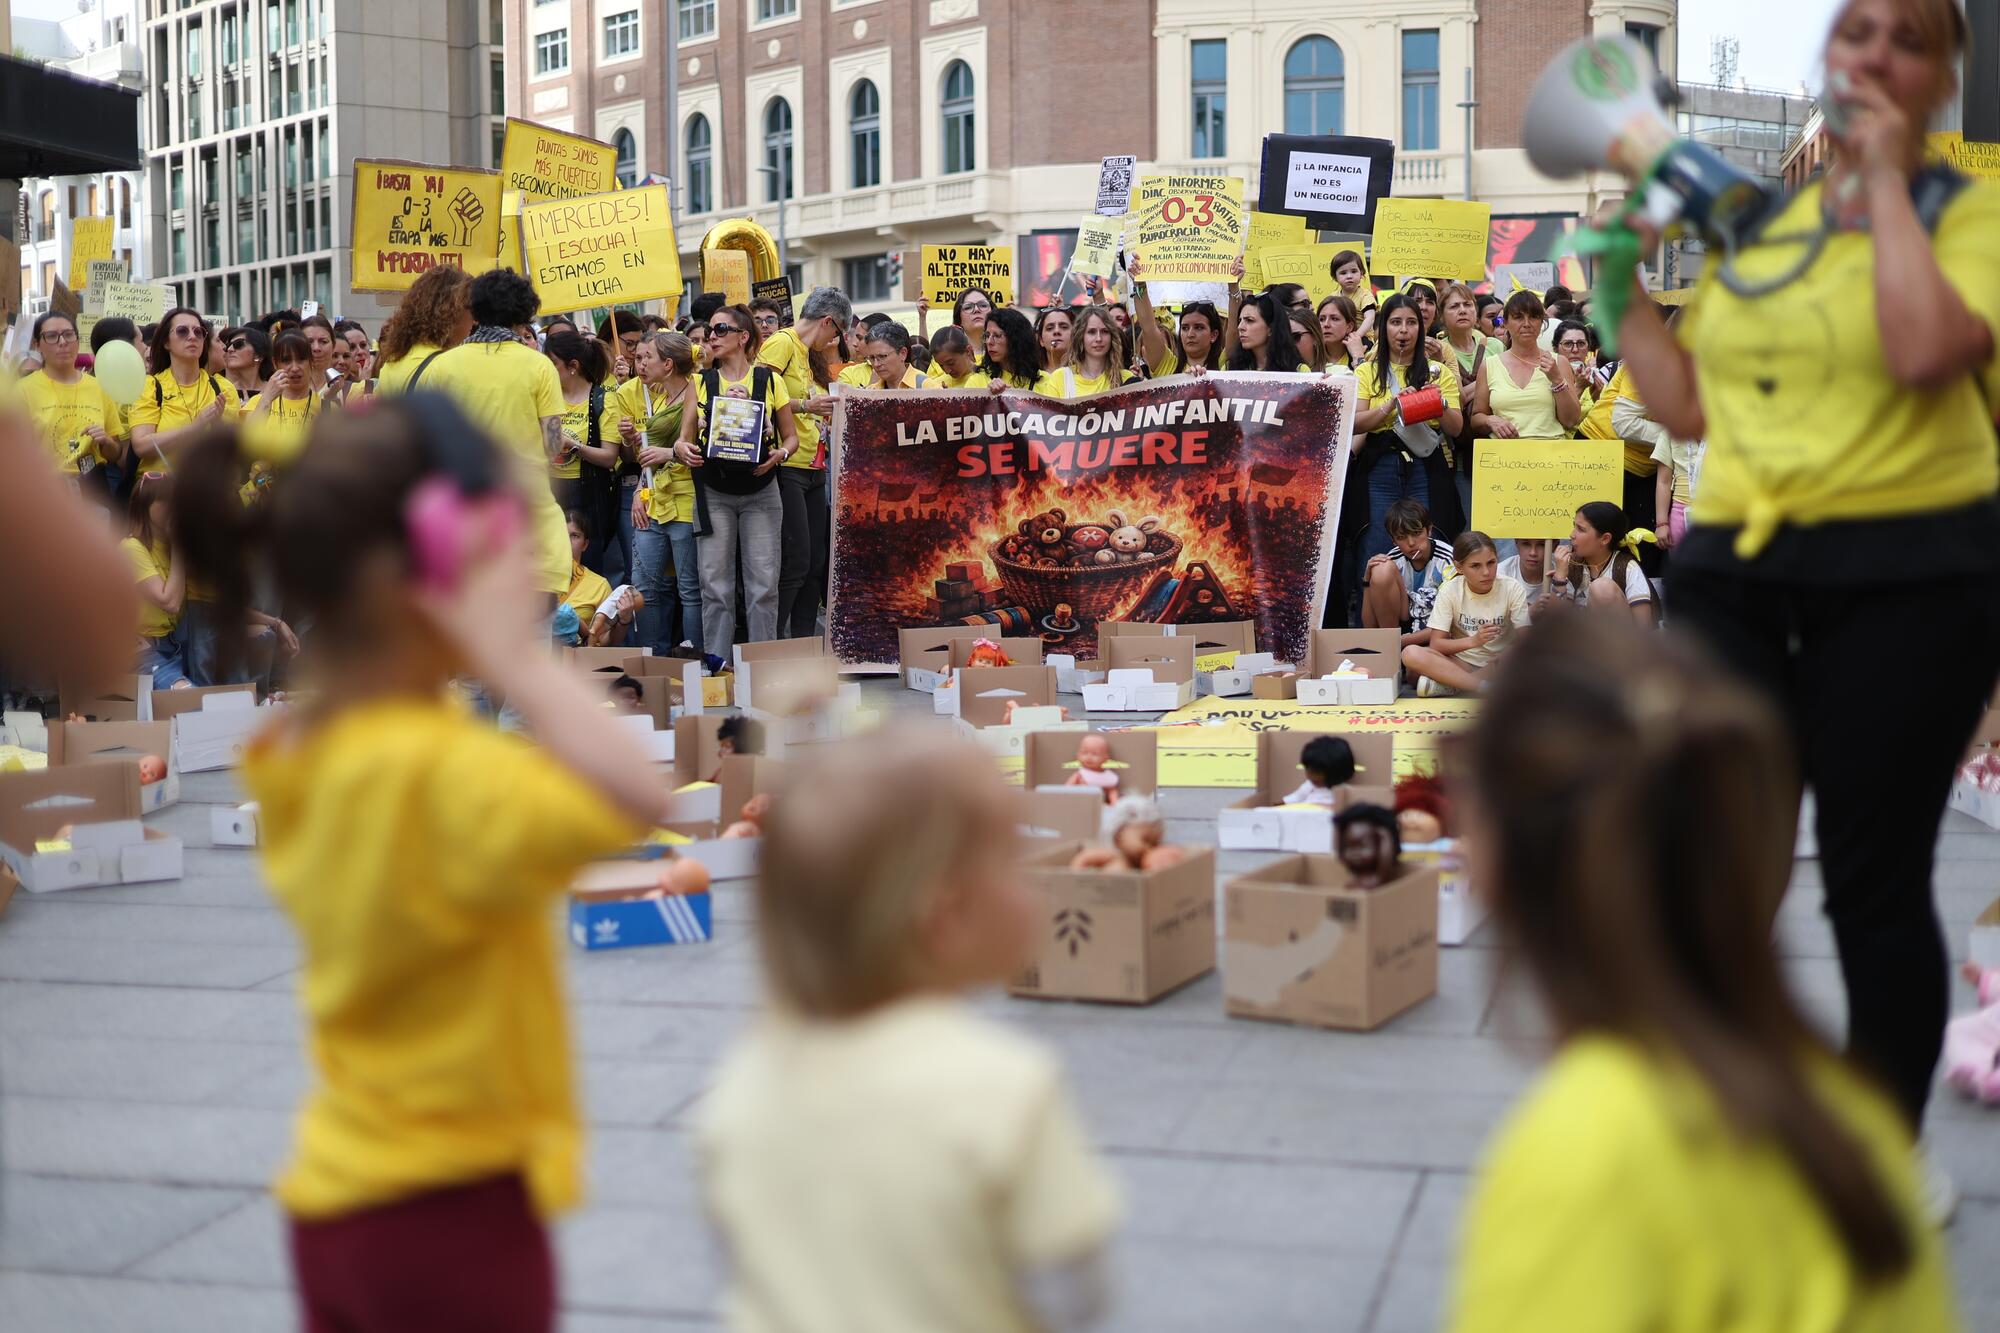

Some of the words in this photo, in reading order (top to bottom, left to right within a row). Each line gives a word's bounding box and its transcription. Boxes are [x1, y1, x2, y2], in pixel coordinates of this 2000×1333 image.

[573, 147, 598, 165] SOMOS
[534, 158, 551, 176] MÁS
[558, 164, 601, 189] FUERTES!
[1303, 163, 1316, 171] LA
[1318, 164, 1363, 175] INFANCIA
[377, 170, 410, 191] ¡BASTA
[424, 175, 444, 198] YA!
[1168, 176, 1226, 190] INFORMES
[1313, 178, 1327, 186] NO
[1329, 179, 1341, 187] ES
[1294, 191, 1308, 199] UN
[1310, 192, 1358, 203] NEGOCIO!!
[403, 196, 431, 216] 0-3
[1162, 195, 1215, 226] 0-3
[392, 215, 403, 229] ES
[420, 218, 432, 232] LA
[528, 193, 650, 241] ¡MERCEDES!
[1414, 210, 1433, 223] UNA
[389, 230, 421, 245] ETAPA
[429, 232, 448, 247] MÁS
[1140, 224, 1201, 244] BUROCRACIA
[1251, 226, 1282, 238] TIEMPO
[938, 248, 957, 261] NO
[968, 248, 995, 261] HAY
[92, 262, 123, 272] NORMATIVA
[540, 257, 606, 285] ESTAMOS
[623, 250, 645, 268] EN
[1154, 263, 1175, 274] POCO
[1270, 258, 1308, 274] TODO
[94, 272, 122, 281] ESTATAL
[110, 285, 121, 293] NO
[577, 276, 623, 298] LUCHA
[897, 422, 938, 446] LA
[946, 408, 1125, 441] EDUCACIÓN
[1133, 398, 1284, 429] INFANTIL
[957, 442, 1015, 478] SE
[1029, 431, 1208, 471] MUERE
[1491, 484, 1504, 492] en
[1514, 481, 1532, 491] la
[1503, 507, 1571, 518] EQUIVOCADA
